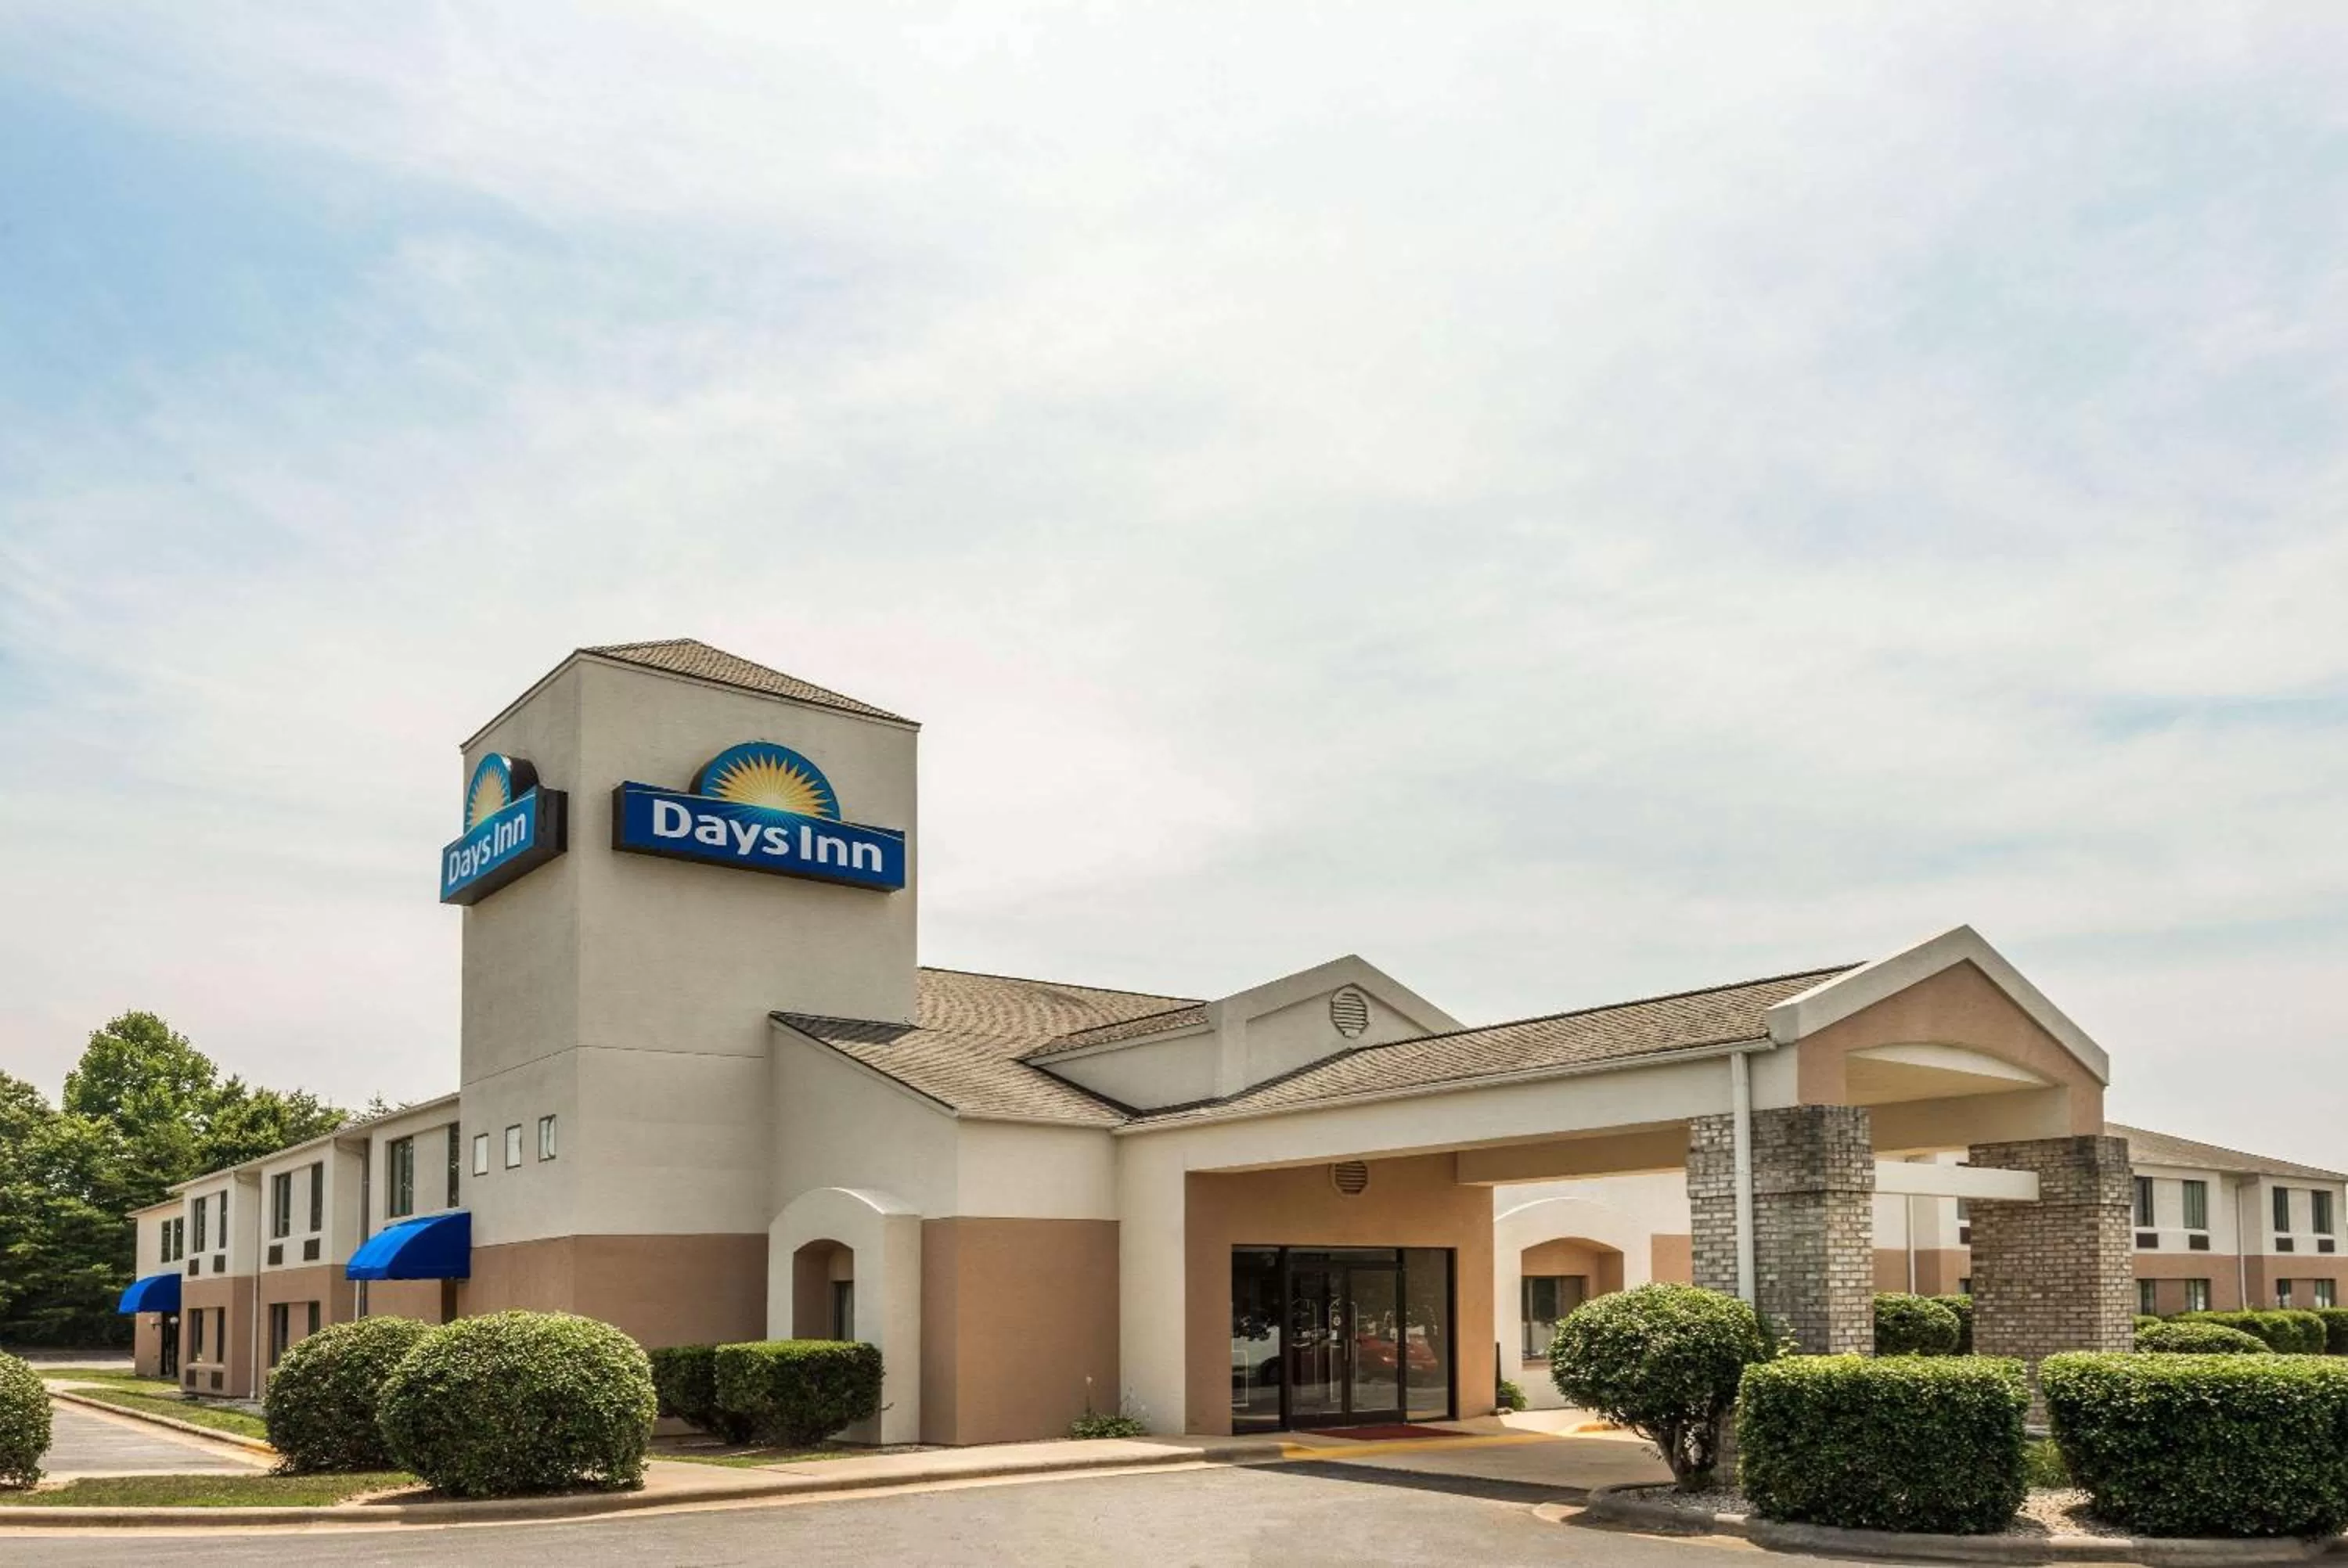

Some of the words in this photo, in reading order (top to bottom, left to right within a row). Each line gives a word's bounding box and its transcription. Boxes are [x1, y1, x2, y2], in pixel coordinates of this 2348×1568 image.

[448, 834, 491, 886] Days
[494, 813, 527, 857] Inn
[653, 799, 790, 855] Days
[800, 825, 883, 872] Inn
